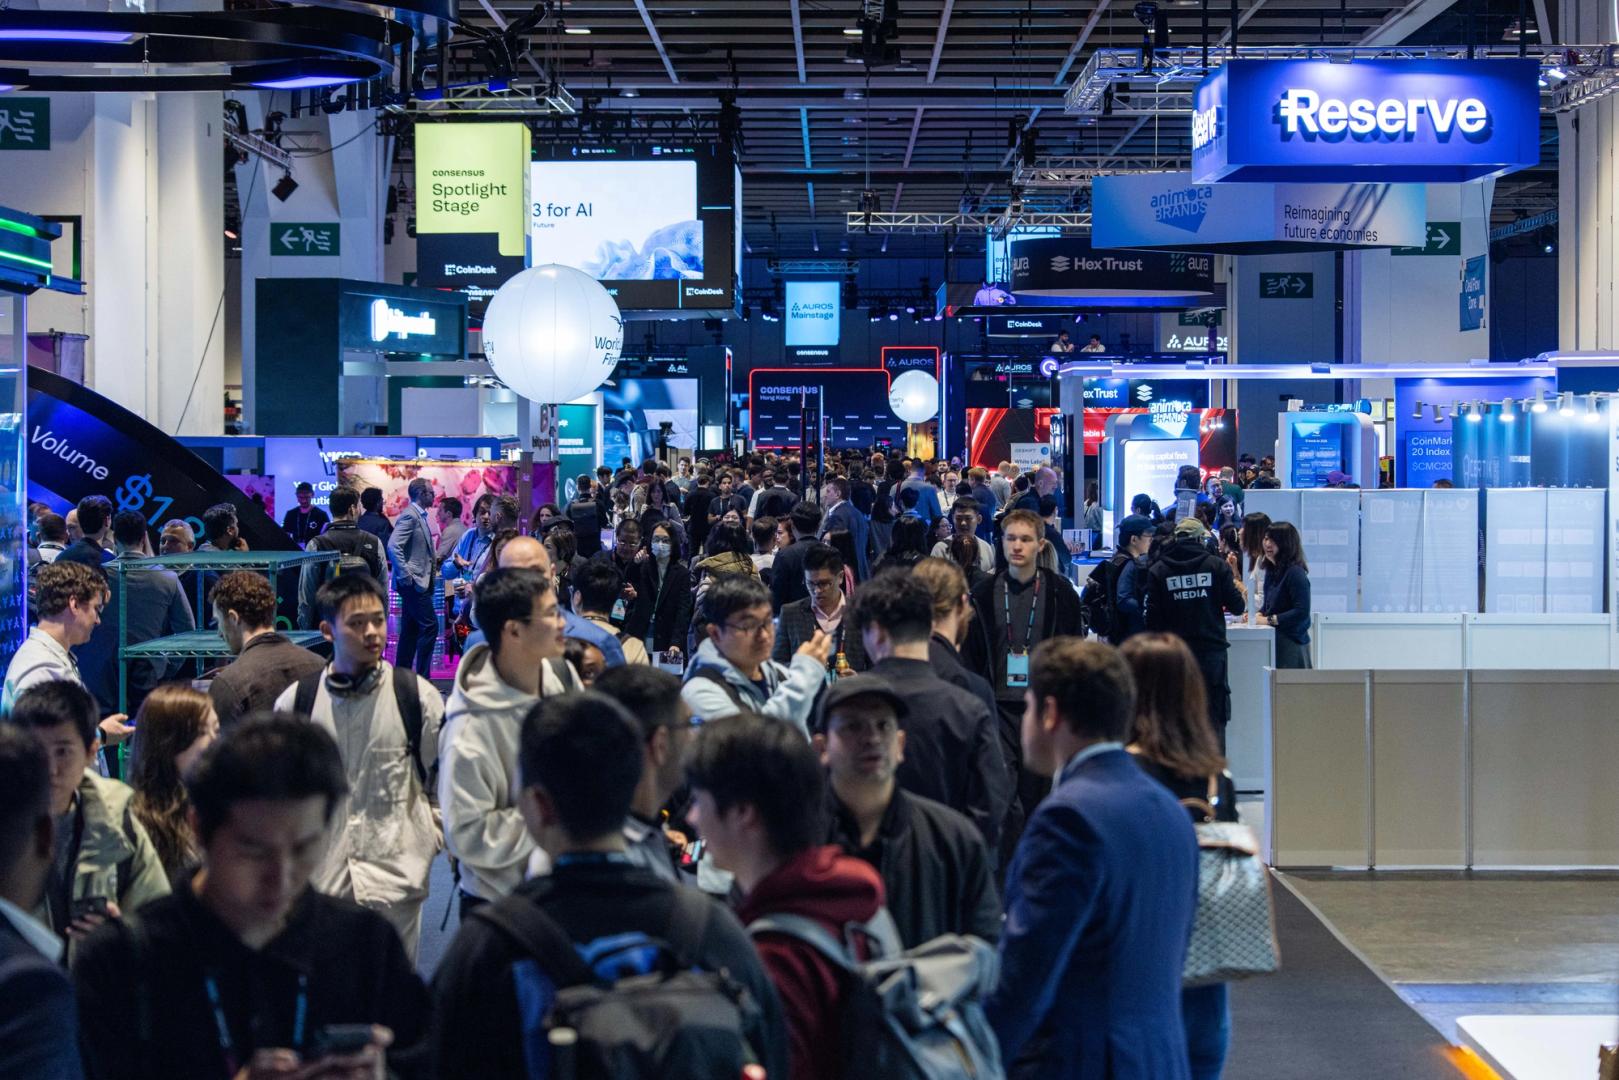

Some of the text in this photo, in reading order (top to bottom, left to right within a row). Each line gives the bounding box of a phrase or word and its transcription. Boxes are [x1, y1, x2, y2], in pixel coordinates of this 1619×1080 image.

[1280, 88, 1487, 134] Reserve
[432, 183, 507, 199] Spotlight
[1151, 187, 1212, 208] animoca
[432, 200, 480, 215] Stage
[532, 203, 593, 217] 3 for AI
[1155, 200, 1208, 221] BRANDS
[1284, 204, 1350, 225] Reimagining
[1284, 223, 1378, 242] future economies
[456, 265, 497, 274] CoinDesk
[1074, 257, 1143, 271] Hex Trust
[1188, 256, 1209, 270] aura
[791, 312, 834, 320] Mainstage
[1014, 320, 1043, 328] CoinDesk
[1094, 388, 1118, 399] Trust
[1150, 399, 1192, 414] animoca
[31, 425, 109, 480] Volume
[1412, 448, 1450, 456] 20 Index
[1173, 589, 1209, 600] MEDIA
